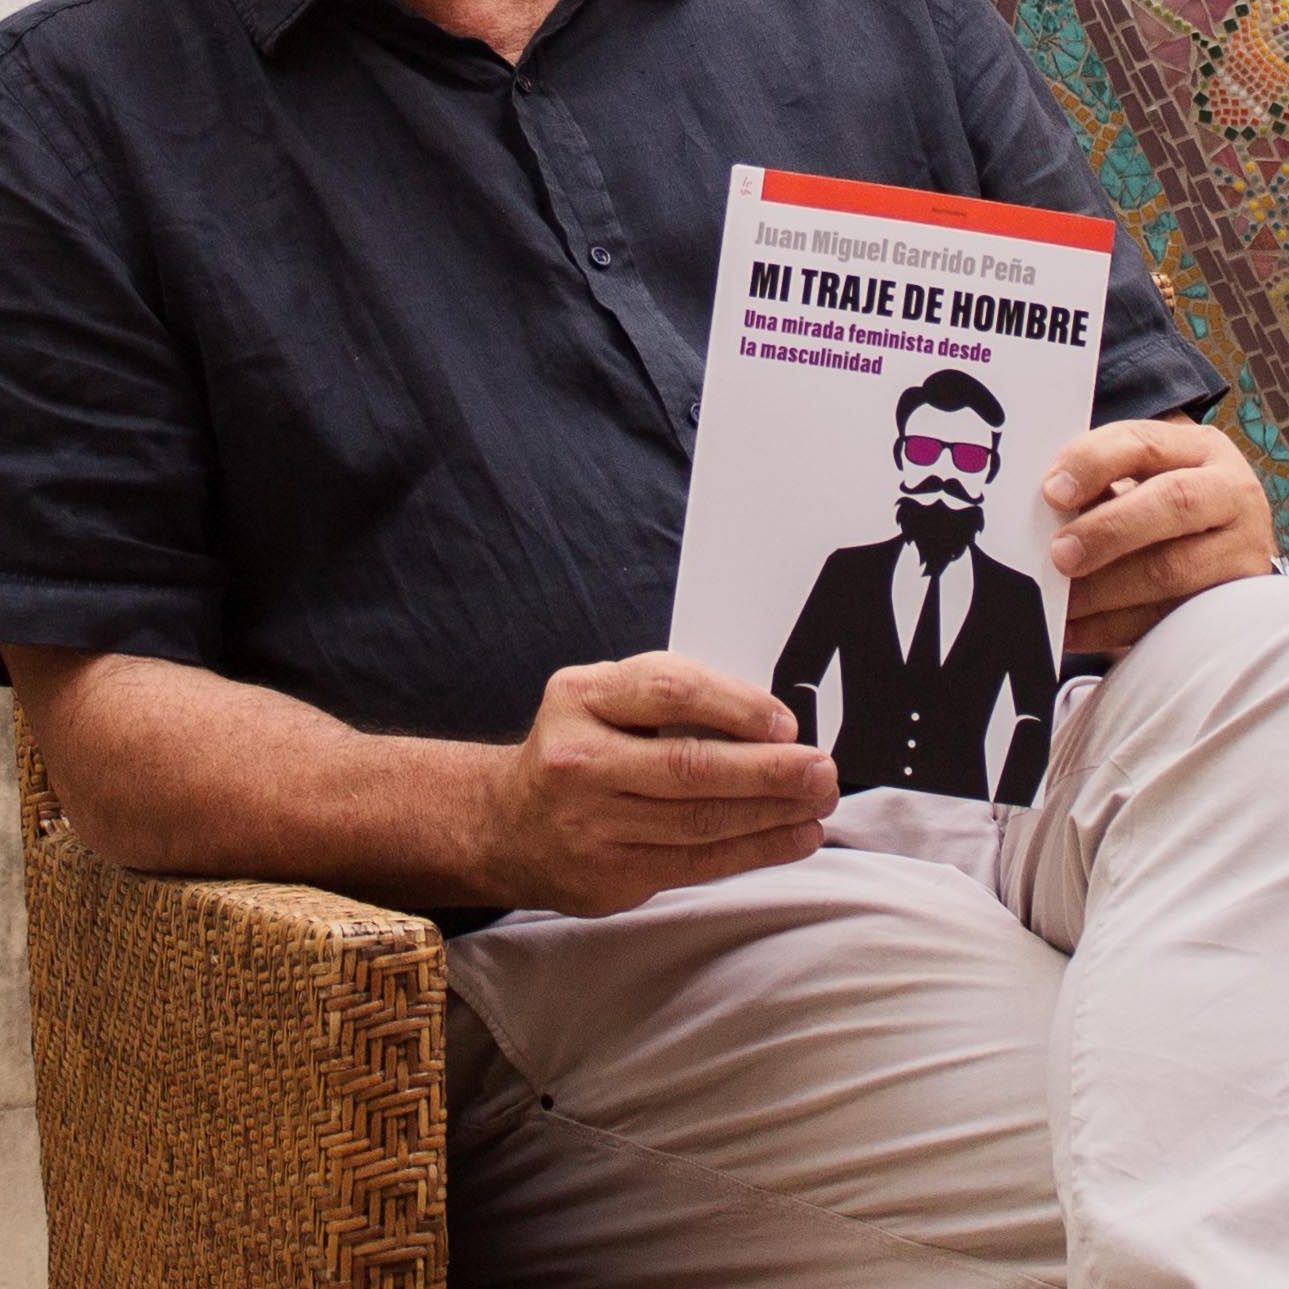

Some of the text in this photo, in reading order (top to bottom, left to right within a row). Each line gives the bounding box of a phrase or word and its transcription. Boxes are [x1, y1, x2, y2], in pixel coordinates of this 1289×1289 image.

[755, 222, 1037, 286] Juan Miguel Garrido Peña
[749, 261, 1090, 348] MI TRAJE DE HOMBRE
[739, 336, 885, 376] la masculinidad
[744, 309, 992, 364] Una mirada feminista desde
